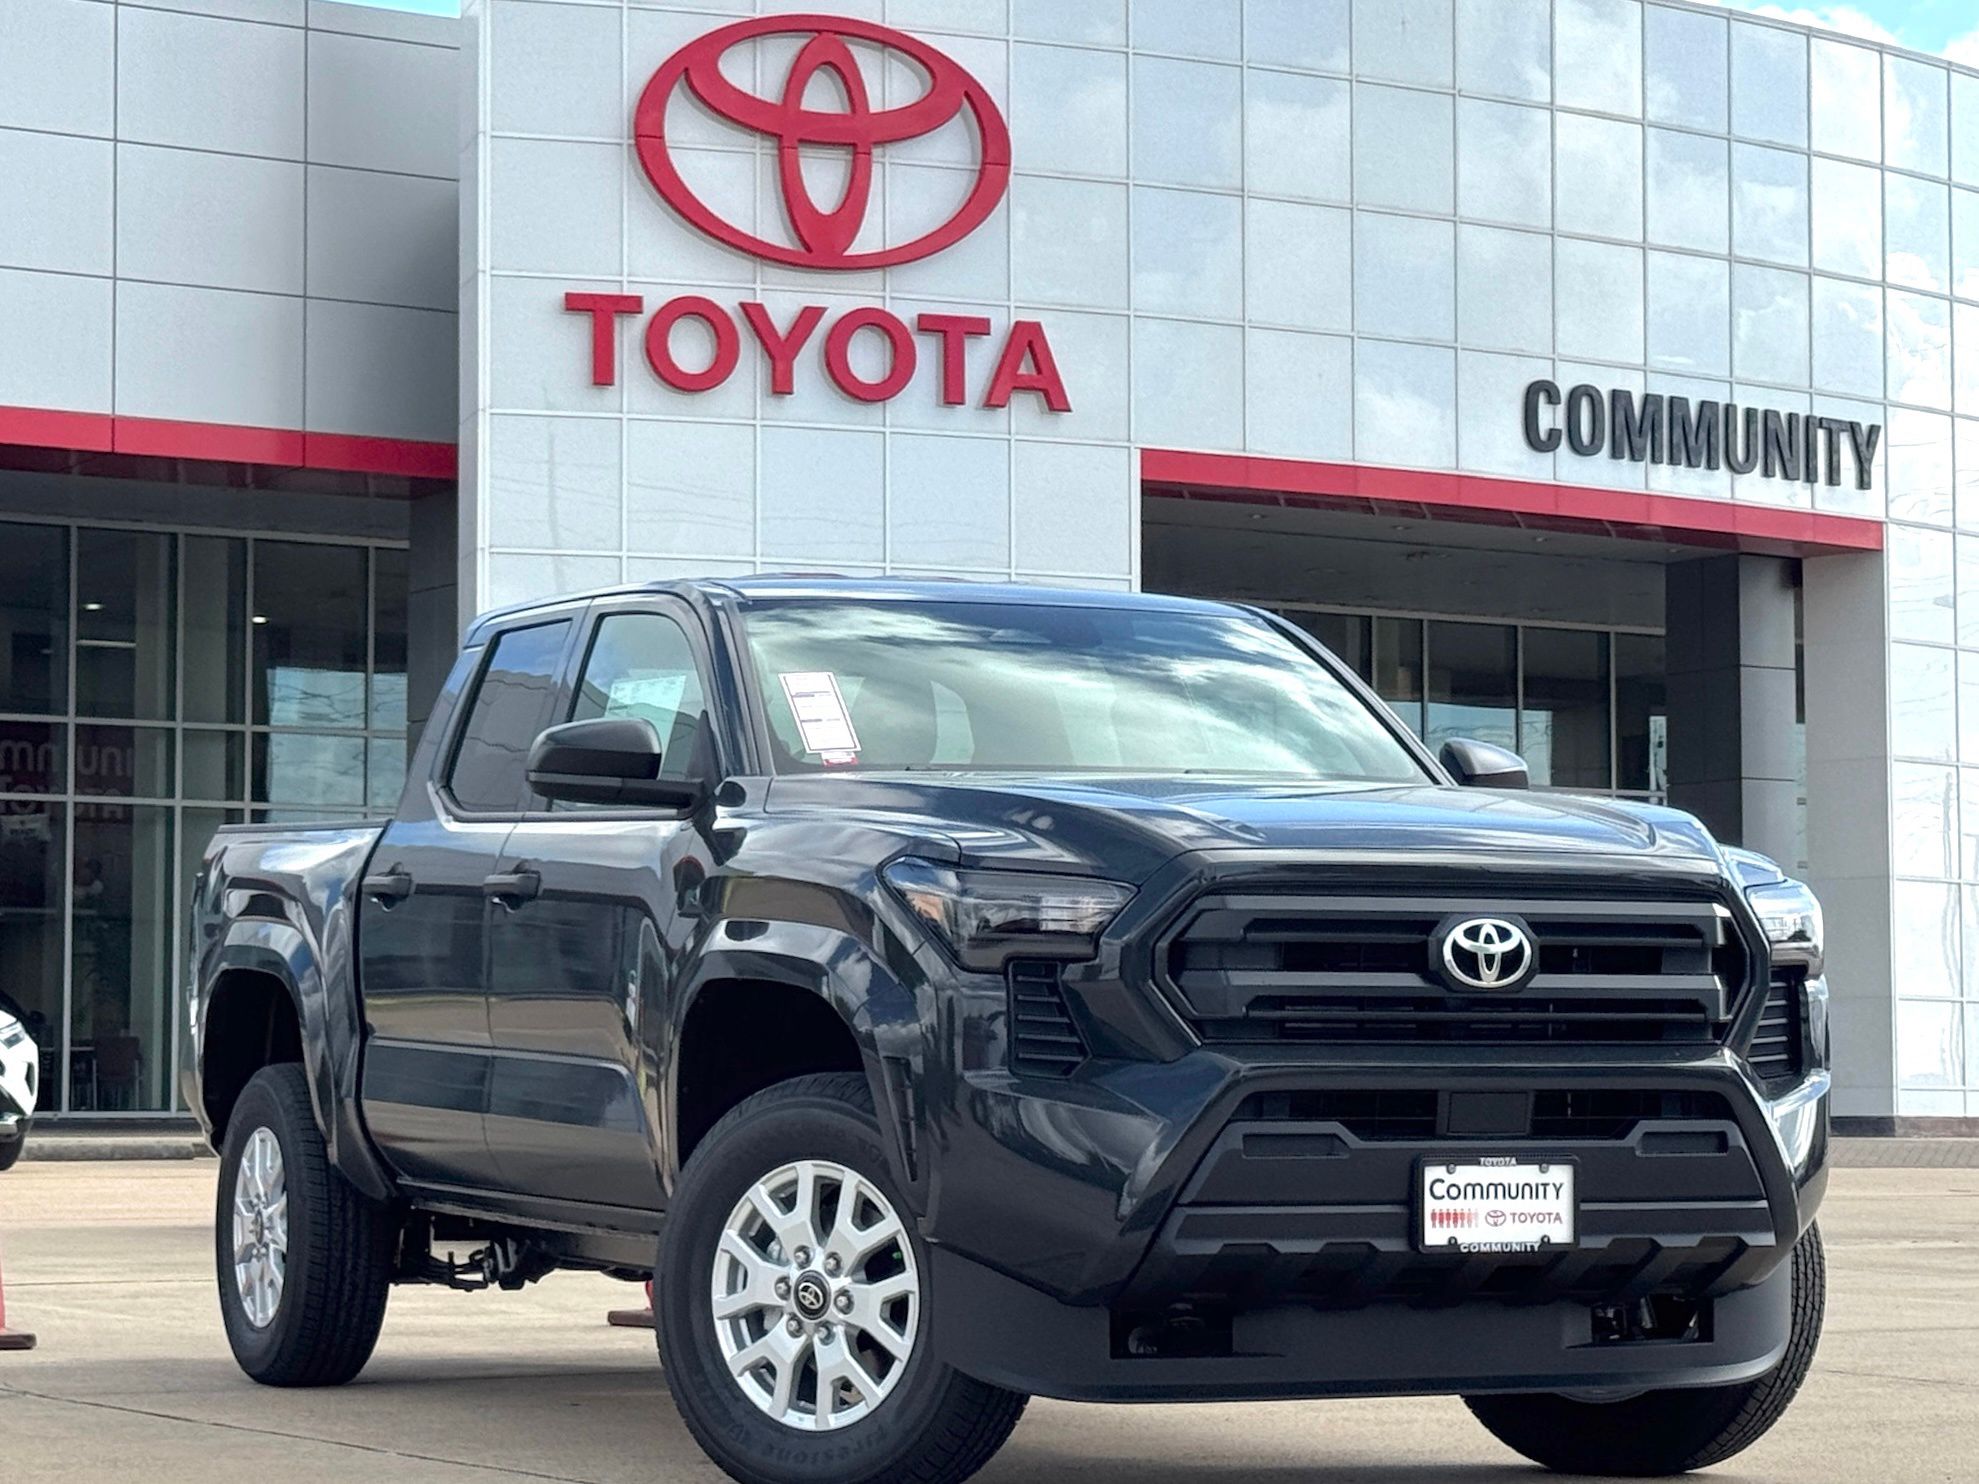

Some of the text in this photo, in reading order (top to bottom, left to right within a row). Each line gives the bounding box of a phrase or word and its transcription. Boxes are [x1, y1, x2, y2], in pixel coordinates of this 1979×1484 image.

[565, 292, 1073, 413] TOYOTA
[1524, 379, 1881, 490] COMMUNITY
[1480, 1157, 1518, 1167] TOYOTA
[1510, 1212, 1563, 1225] TOYOTA
[1460, 1242, 1540, 1253] COMMUNITY
